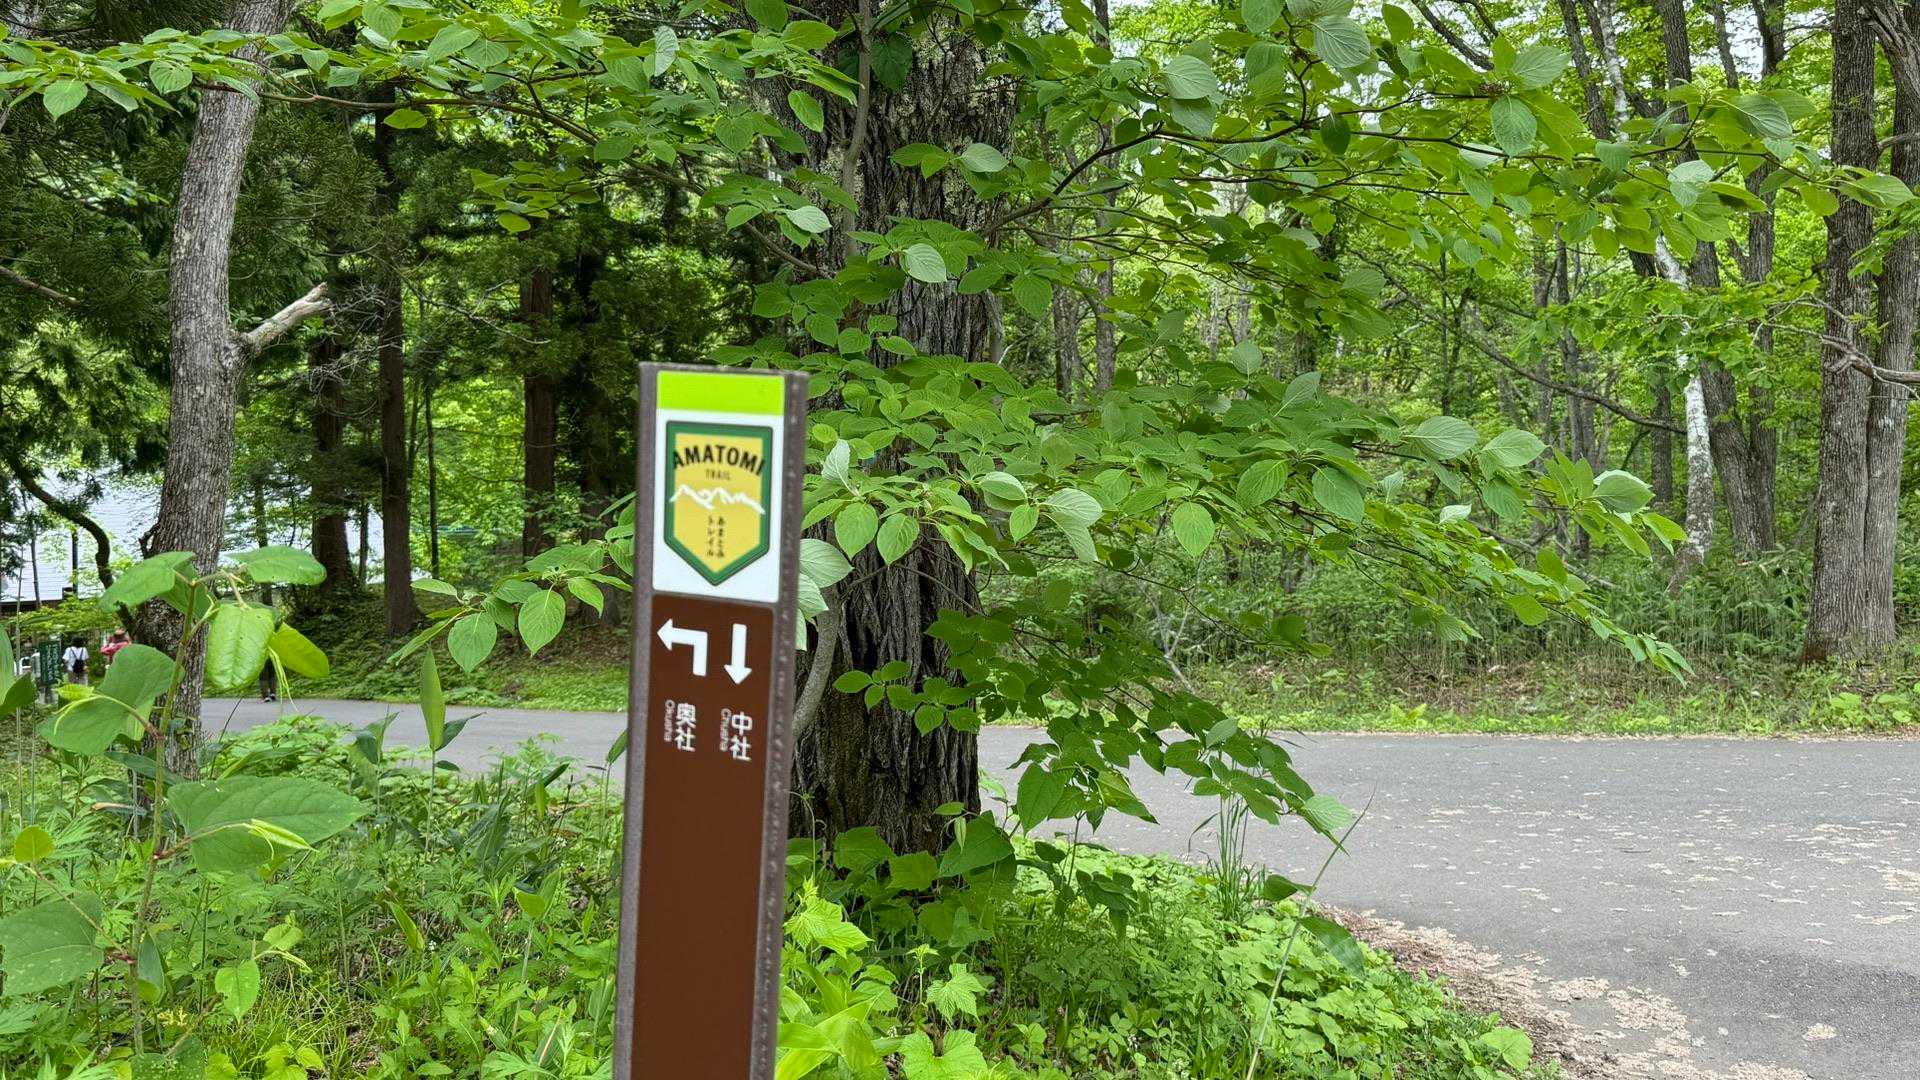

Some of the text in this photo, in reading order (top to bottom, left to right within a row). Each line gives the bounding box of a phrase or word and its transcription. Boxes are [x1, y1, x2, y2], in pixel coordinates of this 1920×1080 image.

[672, 444, 766, 476] AMATOMI
[705, 469, 731, 481] TRAIL
[675, 702, 696, 752] 奥社
[730, 711, 753, 761] 中社
